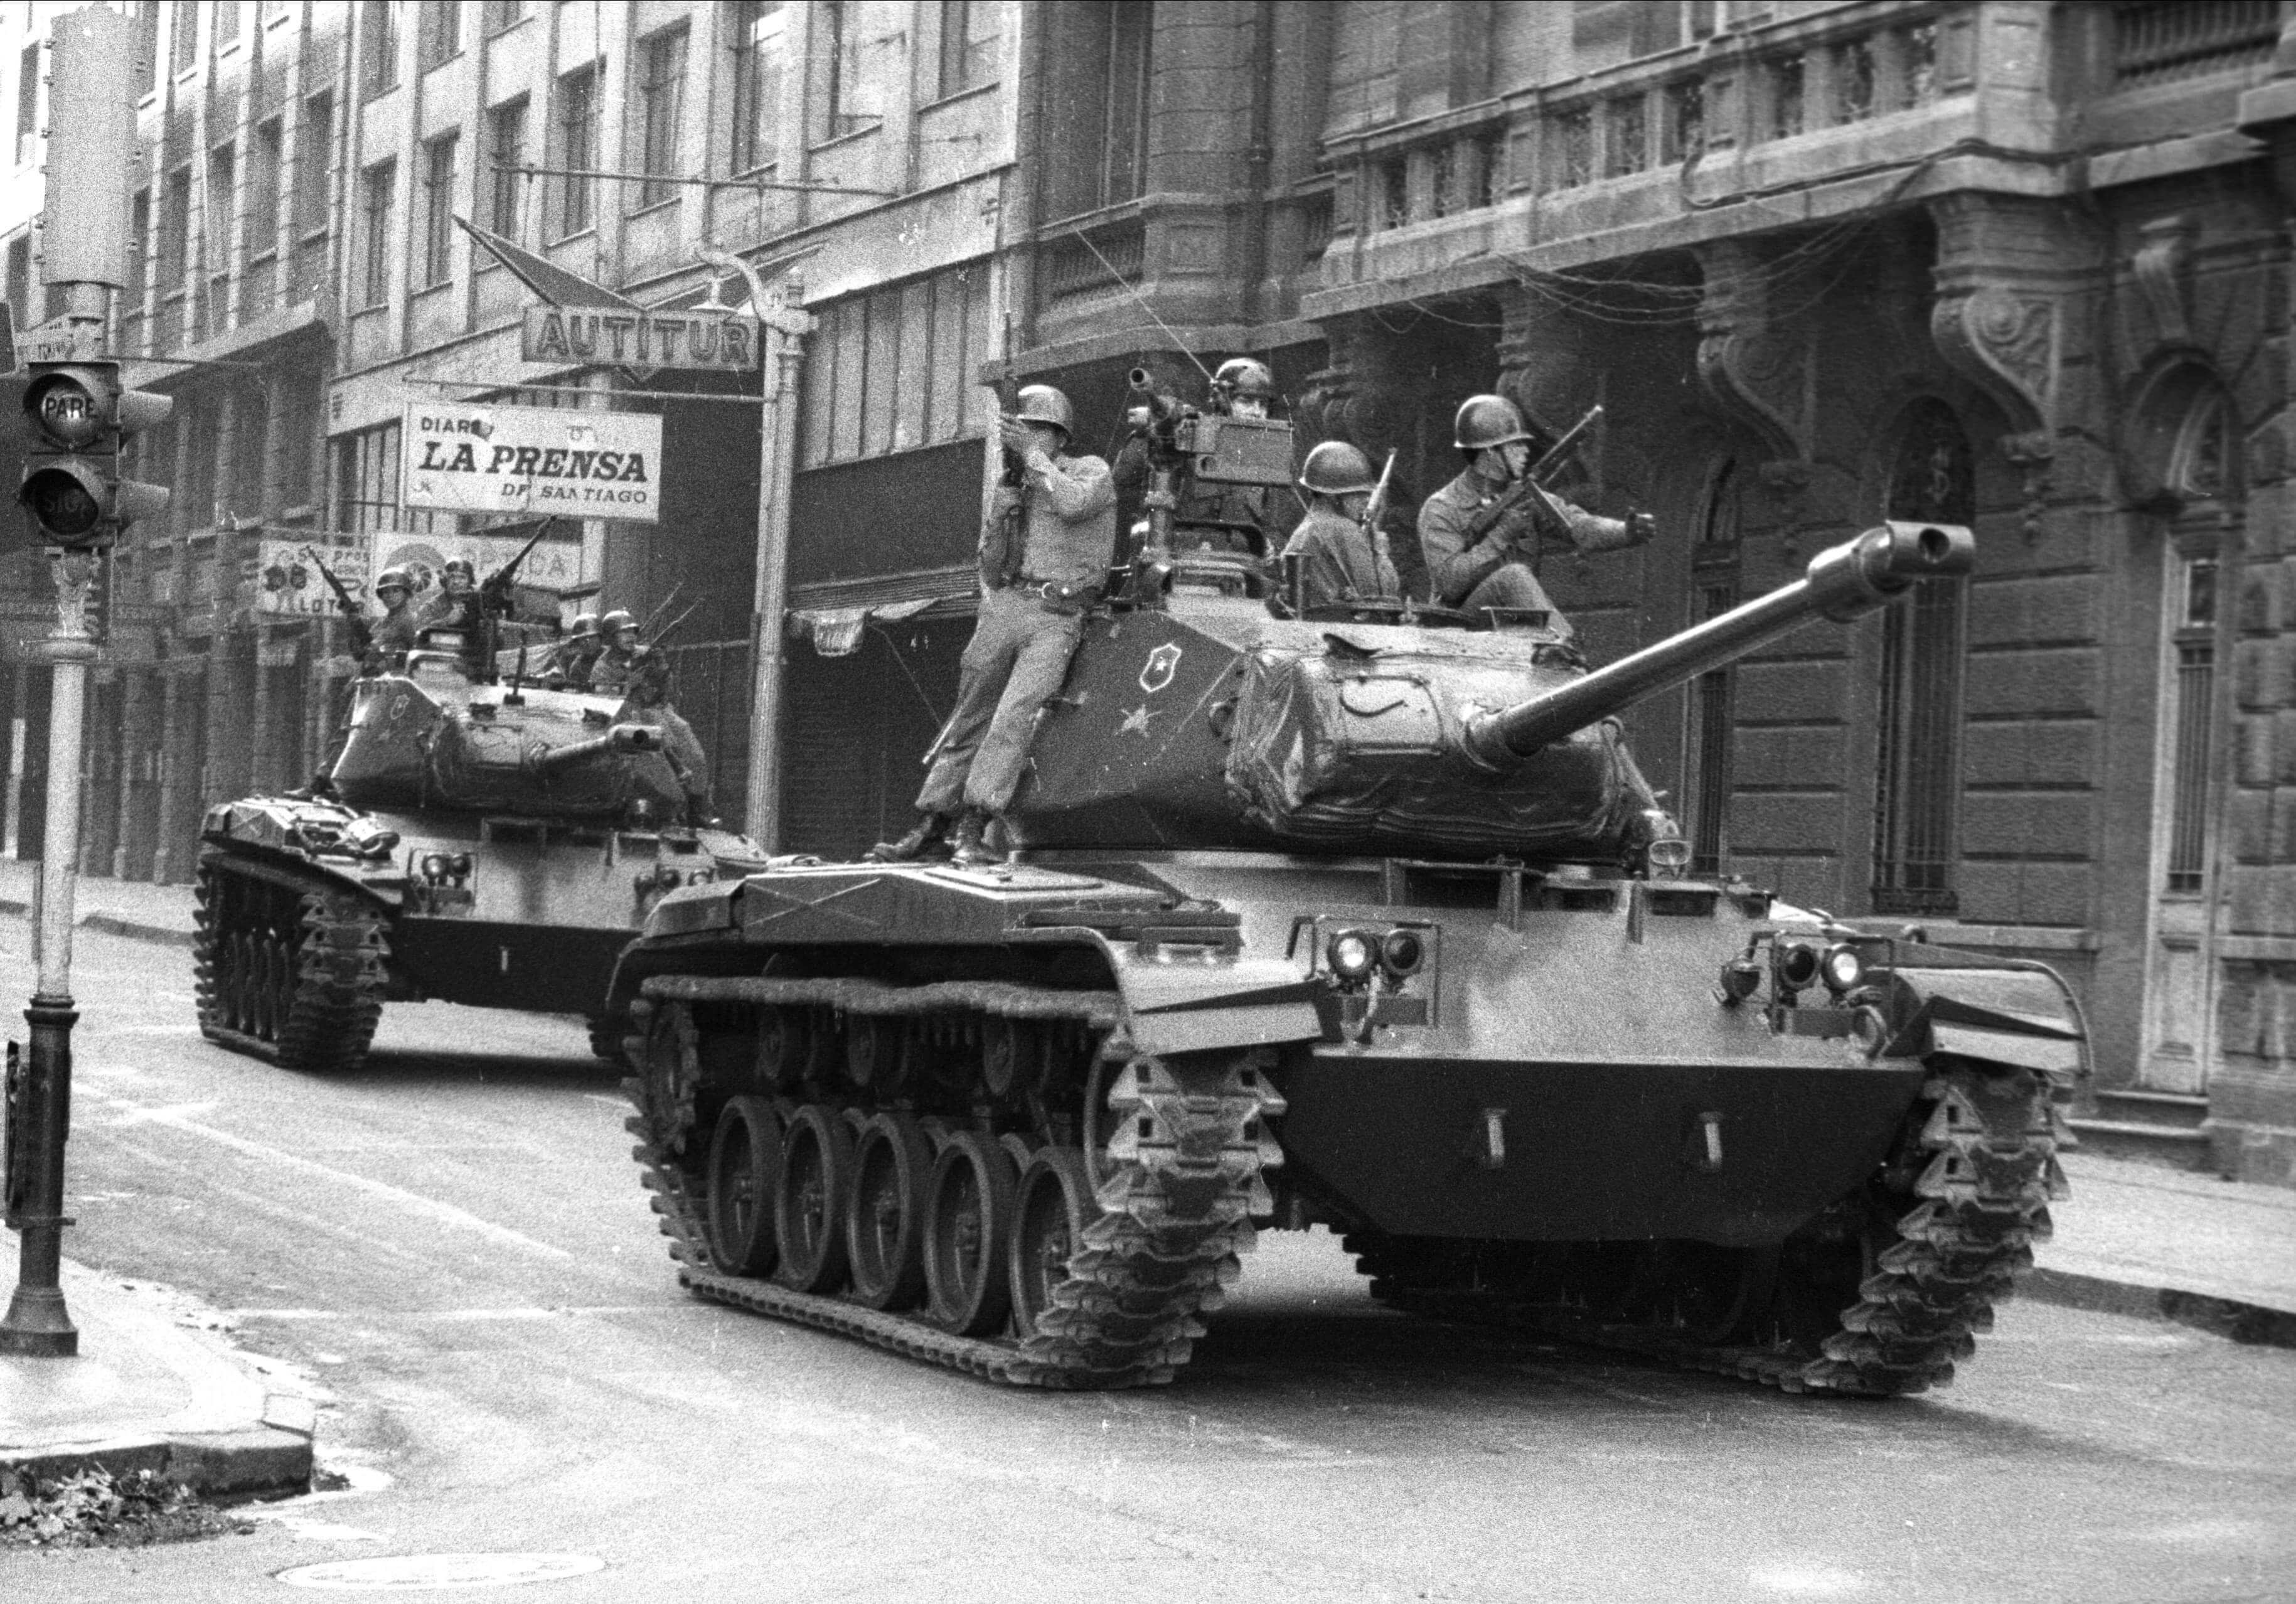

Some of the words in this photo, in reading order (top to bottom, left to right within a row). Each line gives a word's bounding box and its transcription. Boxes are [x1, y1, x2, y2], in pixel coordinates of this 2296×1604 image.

[537, 313, 749, 364] AUTITUR
[45, 397, 98, 419] PARE
[420, 416, 494, 436] DIAR
[418, 441, 477, 473] LA
[484, 444, 648, 483] PRENSA
[541, 485, 648, 505] SANTIAGO
